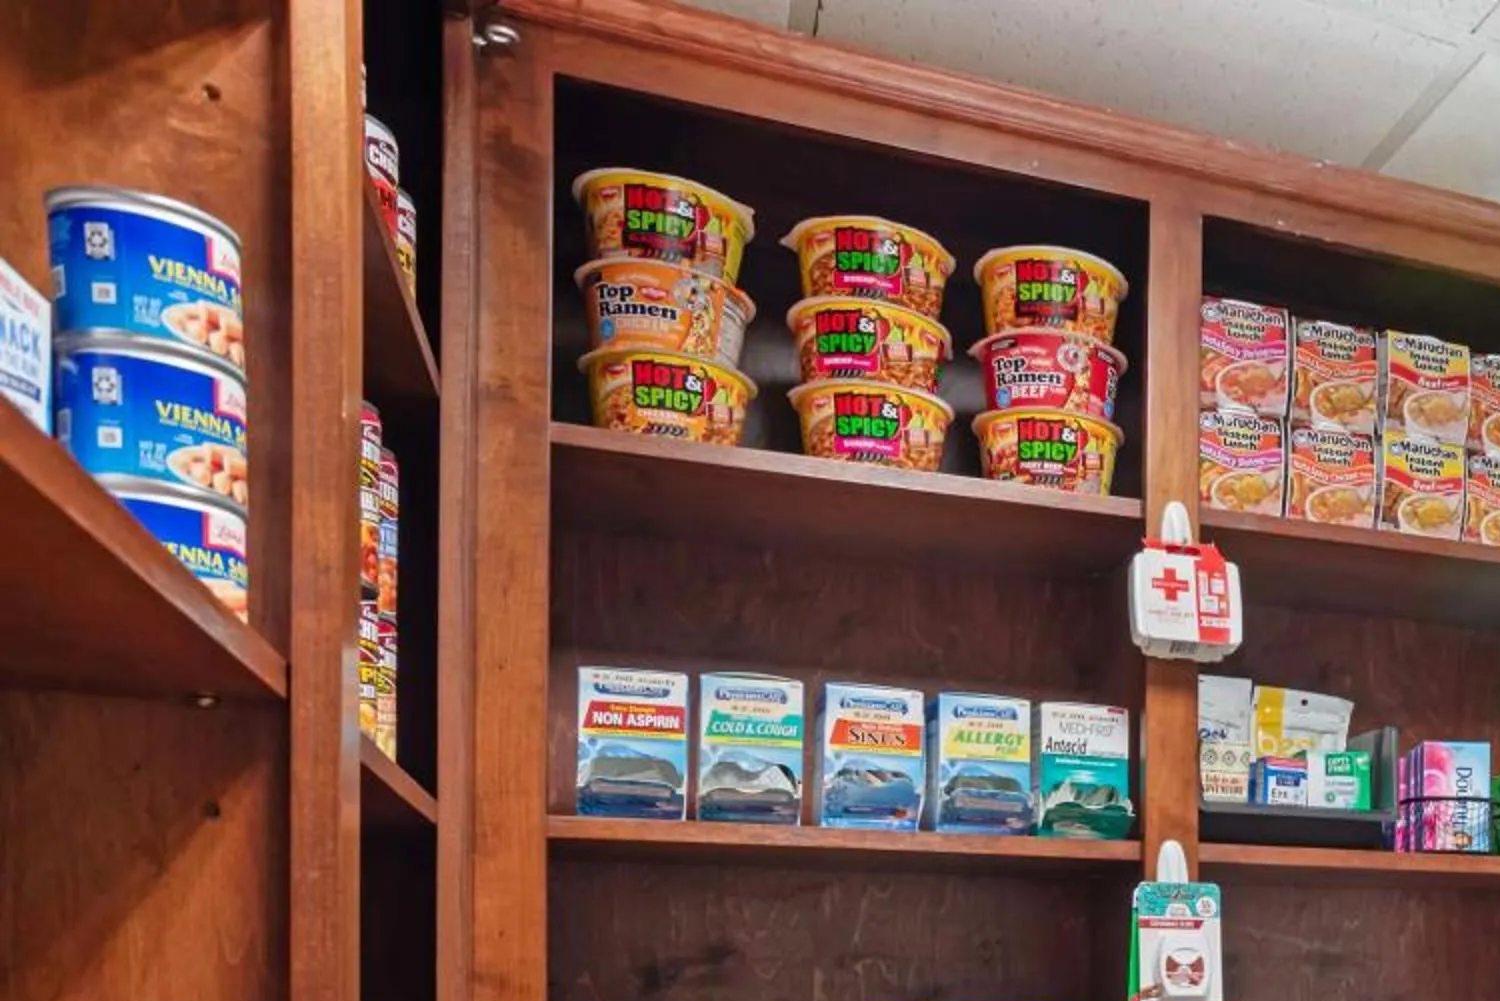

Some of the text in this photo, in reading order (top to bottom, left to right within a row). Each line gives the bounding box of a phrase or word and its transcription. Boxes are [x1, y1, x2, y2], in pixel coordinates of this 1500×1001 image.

[626, 186, 678, 212] HOT
[626, 209, 695, 238] SPICY
[836, 229, 881, 249] HOT
[837, 251, 898, 273] SPICY
[1018, 261, 1062, 283] HOT
[147, 254, 229, 296] VIENNA
[597, 282, 634, 301] Top
[1019, 283, 1073, 302] SPICY
[599, 301, 678, 321] Ramen
[1216, 304, 1282, 326] Maruchan
[816, 312, 860, 333] HOT
[818, 333, 875, 354] SPICY
[1311, 325, 1375, 344] Maruchan
[1405, 337, 1463, 357] Maruchan
[633, 362, 687, 388] HOT
[995, 357, 1025, 375] Top
[996, 371, 1062, 388] Ramen
[635, 386, 703, 411] SPICY
[835, 395, 882, 416] HOT
[155, 400, 234, 436] VIENNA
[836, 417, 898, 438] SPICY
[1213, 414, 1280, 432] Maruchan
[1018, 421, 1062, 441] HOT
[1307, 431, 1373, 449] Maruchan
[1020, 442, 1077, 462] SPICY
[1401, 440, 1458, 460] Maruchan
[166, 543, 225, 575] ENNA
[592, 711, 680, 730] NON ASPIRIN
[712, 721, 744, 735] COLD
[756, 723, 798, 736] COUGH
[848, 727, 905, 745] SINUS
[955, 730, 1025, 747] ALLERGY
[1045, 736, 1087, 755] Antacid
